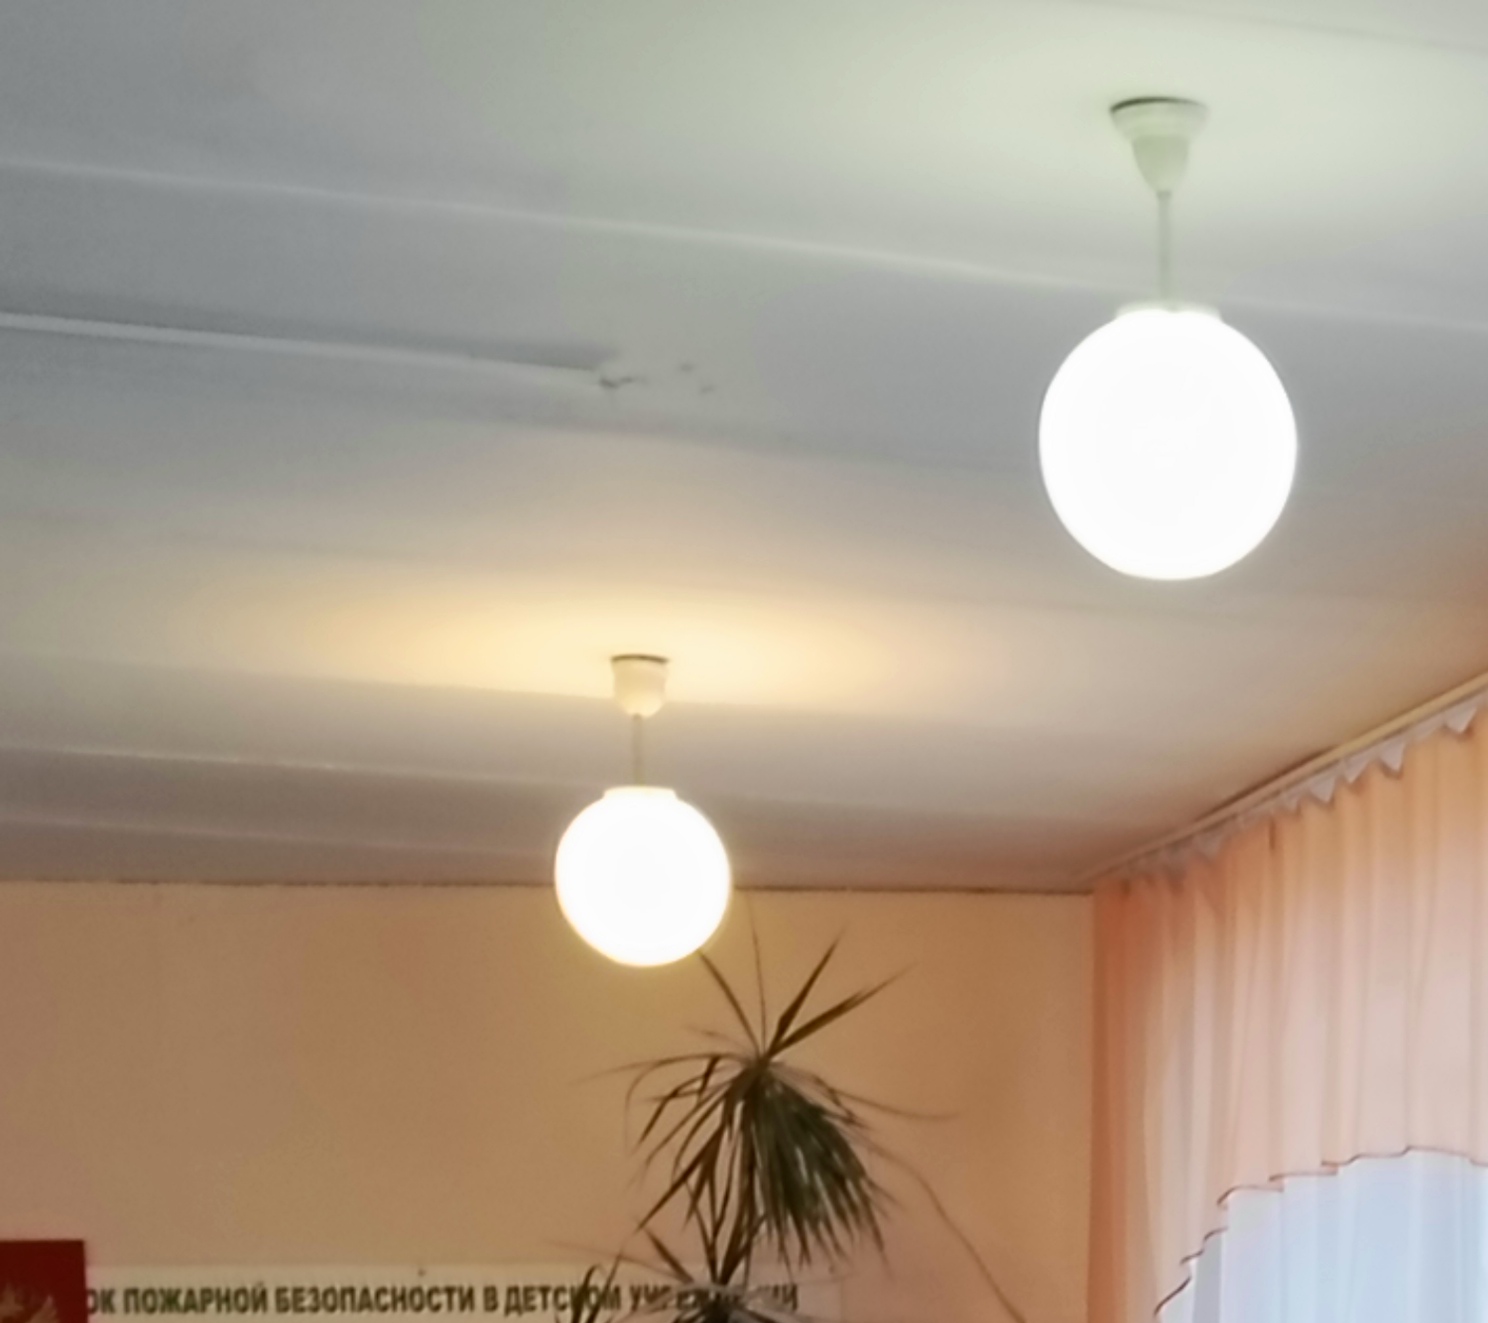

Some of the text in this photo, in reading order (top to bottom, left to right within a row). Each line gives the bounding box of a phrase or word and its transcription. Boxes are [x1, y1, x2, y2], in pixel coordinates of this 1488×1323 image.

[124, 1282, 268, 1314] ПОЖАРНОЙ
[276, 1285, 475, 1313] БЕЗОПАСНОСТИ
[484, 1286, 499, 1312] В
